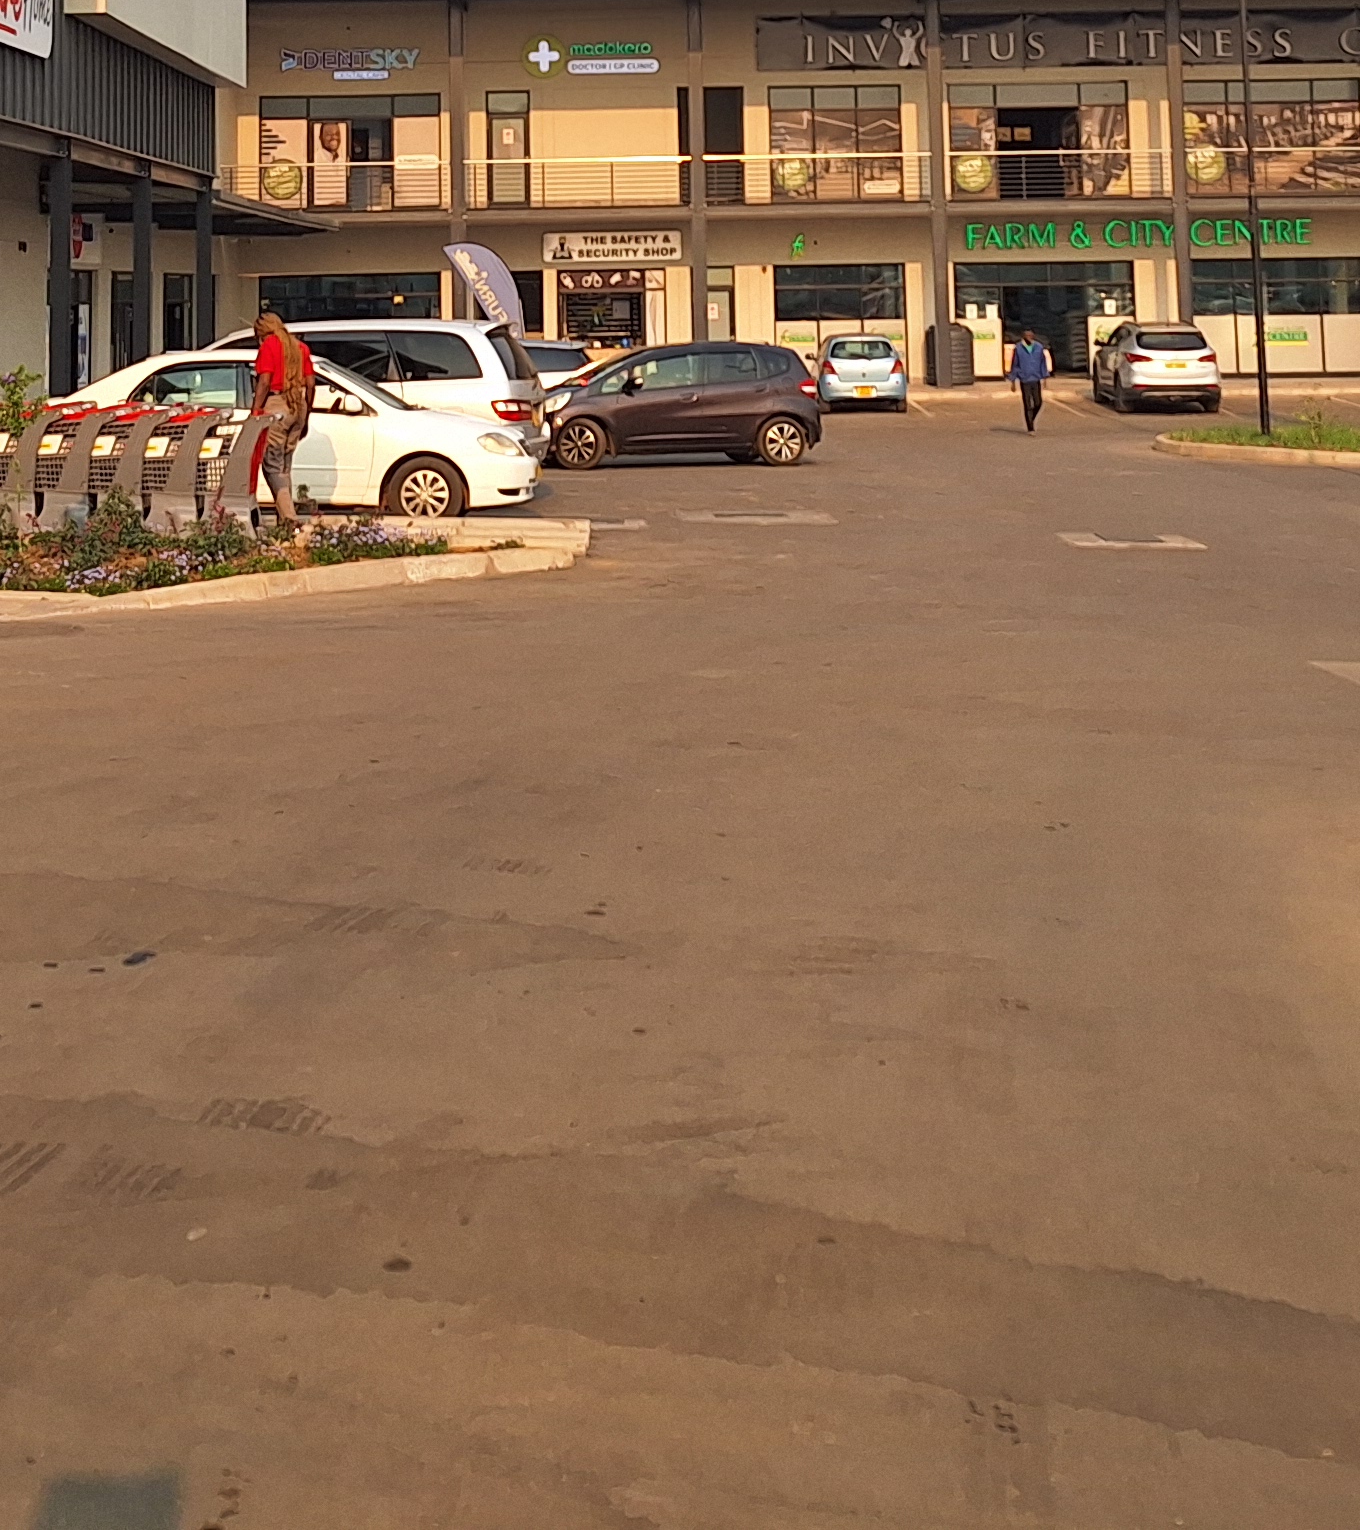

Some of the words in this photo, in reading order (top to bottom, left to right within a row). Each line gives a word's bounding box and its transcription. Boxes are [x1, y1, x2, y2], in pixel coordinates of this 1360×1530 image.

[570, 41, 652, 57] madokero
[805, 23, 1047, 66] INVTUS
[1086, 28, 1292, 59] FITNESS
[302, 48, 420, 70] DENTSKY
[571, 63, 607, 71] DOCTOR
[582, 236, 607, 245] THE
[611, 234, 658, 245] SAFETY
[662, 234, 671, 244] &
[966, 222, 1057, 250] FARM
[1069, 221, 1092, 250] &
[1104, 219, 1175, 248] CITY
[1190, 218, 1313, 247] CENTRE
[577, 248, 639, 258] SECURITY
[643, 247, 678, 258] SHOP
